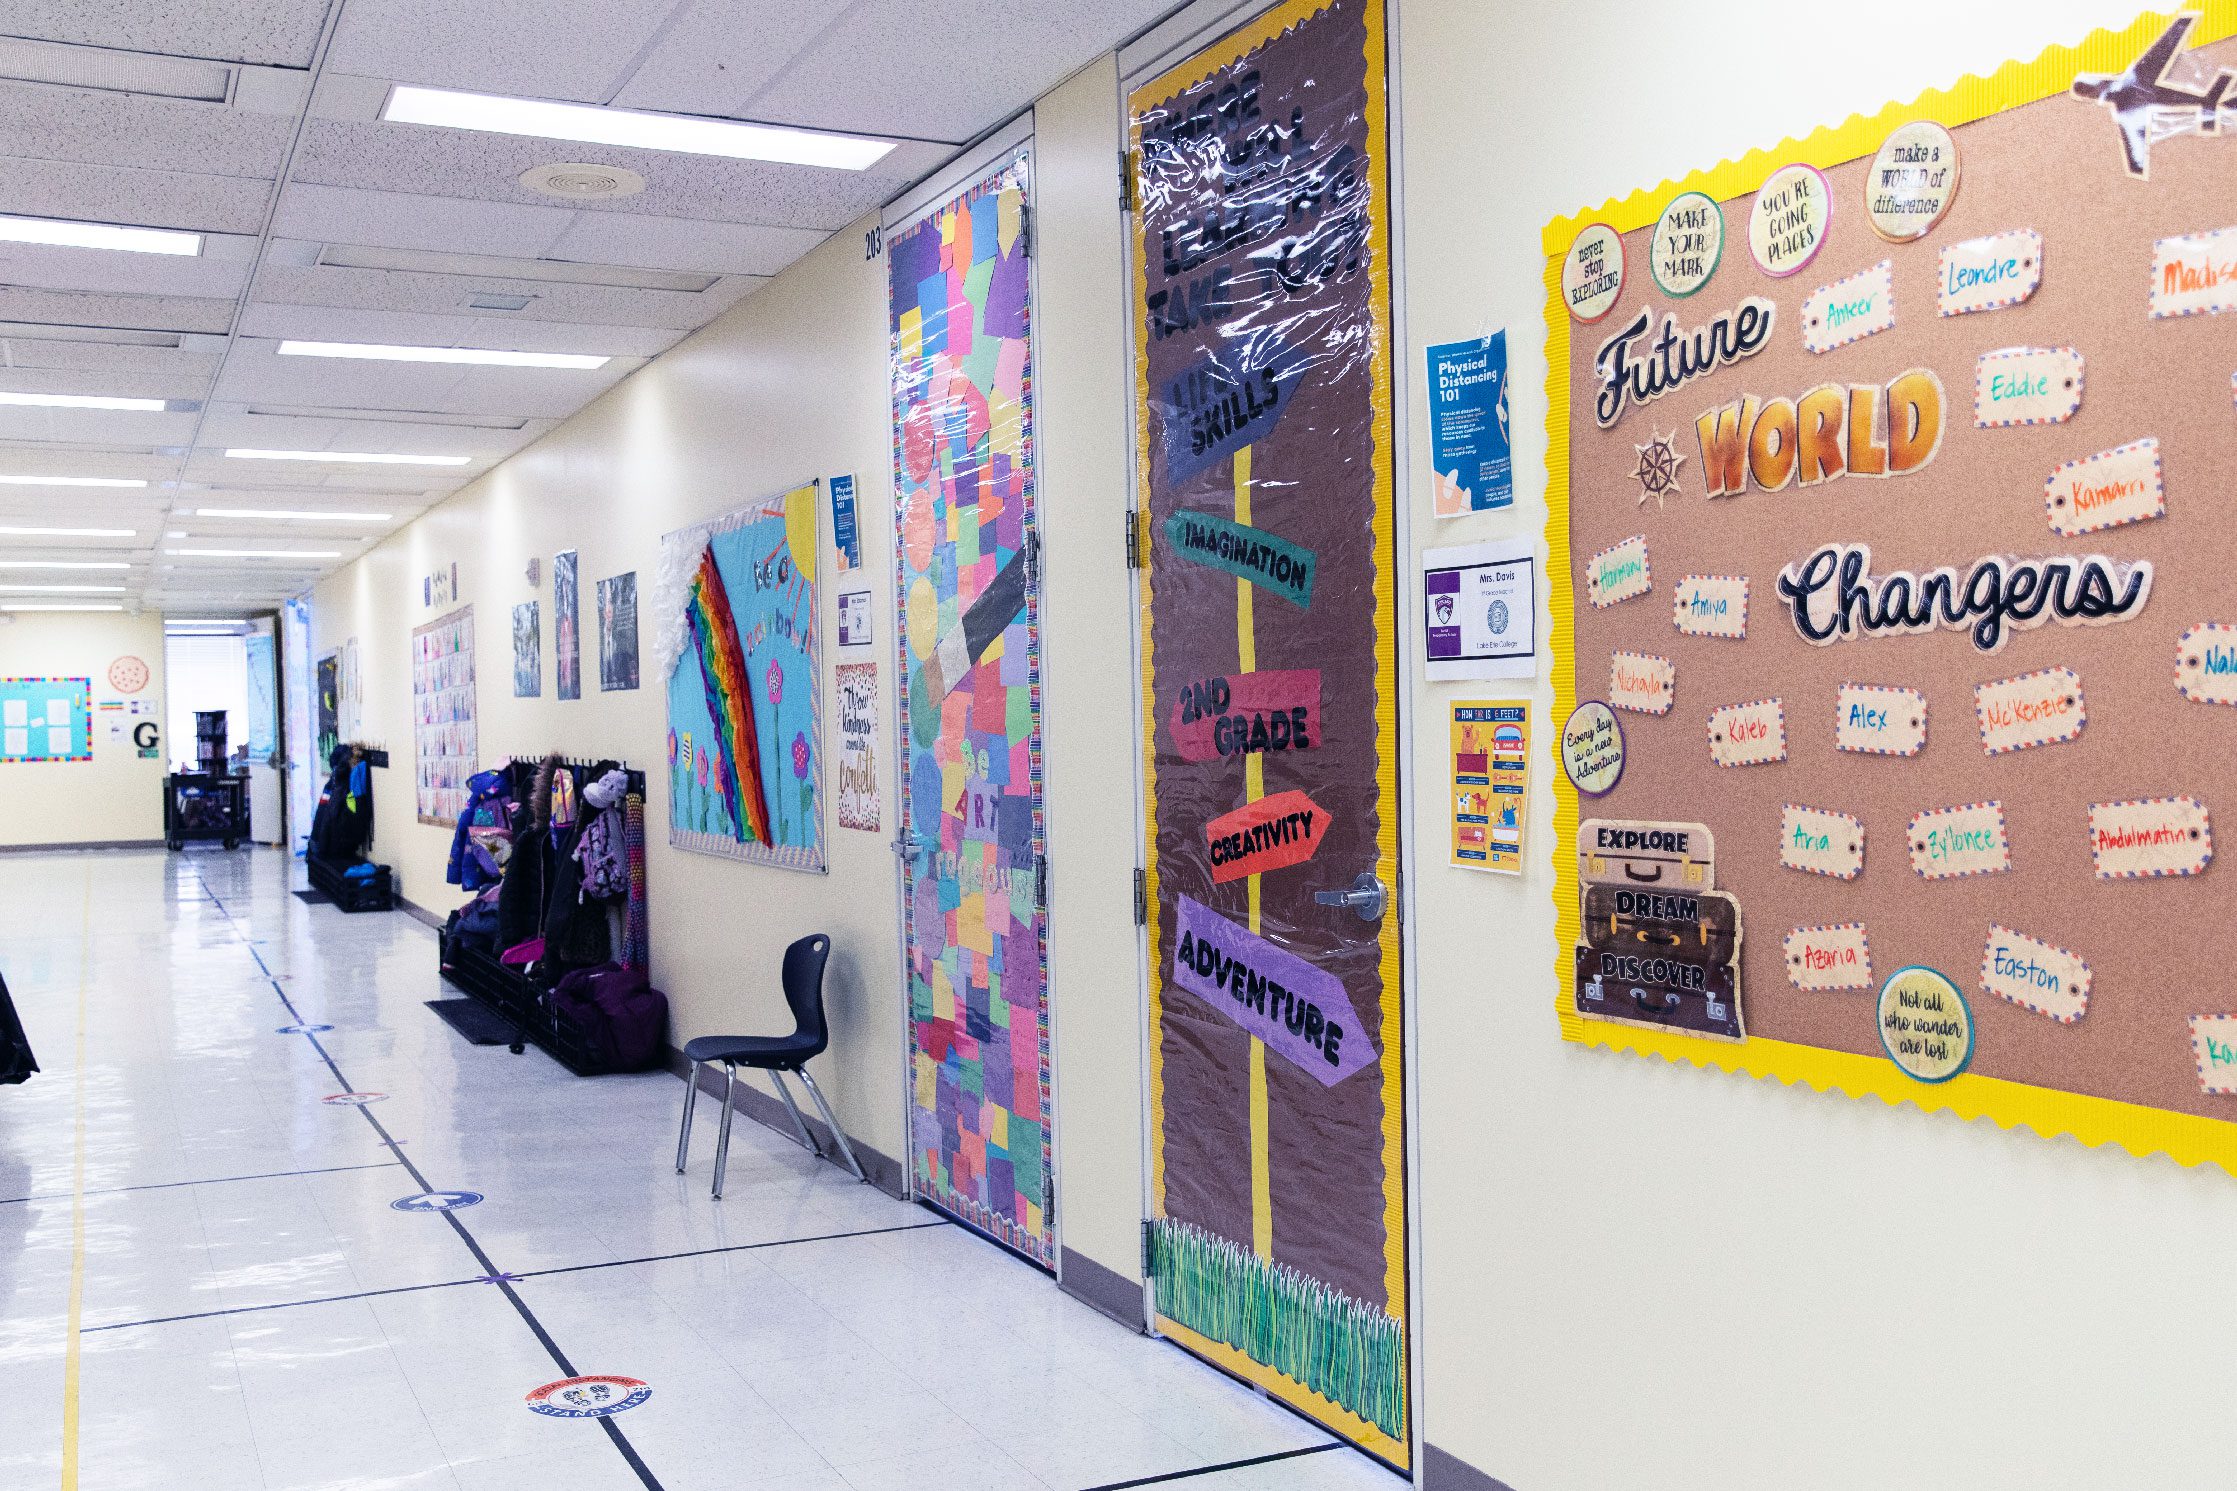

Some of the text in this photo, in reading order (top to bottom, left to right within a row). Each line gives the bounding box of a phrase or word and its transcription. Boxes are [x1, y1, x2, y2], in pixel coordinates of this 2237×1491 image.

[1894, 144, 1940, 164] make a
[1880, 167, 1948, 190] WORLD of
[1763, 177, 1811, 217] YOU'RE
[1873, 193, 1940, 216] difference
[1668, 208, 1708, 232] MAKE
[1769, 207, 1809, 239] GOING
[865, 225, 883, 261] 203
[1578, 239, 1604, 264] never
[1669, 232, 1706, 254] YOUR
[1768, 229, 1815, 264] PLACES
[1584, 258, 1604, 281] stop
[1663, 257, 1706, 279] MARK
[1948, 258, 2020, 296] Leondre
[1571, 269, 1619, 306] EXPLORING
[1438, 354, 1487, 376] Physical
[1439, 368, 1497, 389] Distancing
[1597, 305, 1771, 424] Future
[1439, 389, 1460, 402] 101
[1991, 373, 2049, 402] Eddie
[1191, 366, 1279, 457] SKILLS
[1694, 371, 1942, 496] WORLD
[2071, 478, 2146, 516] Kamarri
[1184, 521, 1307, 591] IMAGINATION
[1479, 570, 1515, 584] Mrs. Davis
[1690, 590, 1728, 617] Amiya
[1778, 548, 2145, 651] Changers
[2204, 644, 2237, 675] Nal
[1179, 676, 1231, 725] 2ND
[1485, 709, 1491, 720] IS
[1500, 709, 1519, 719] FEET?
[1213, 706, 1311, 757] GRADE
[1566, 717, 1613, 748] Every day
[1728, 717, 1768, 744] Kaleb
[1849, 703, 1888, 733] Alex
[133, 722, 160, 748] G
[1573, 736, 1613, 763] is a new
[839, 744, 878, 814] confetti
[1575, 752, 1621, 782] Adventure
[954, 788, 1000, 832] ART
[1210, 810, 1313, 867] CREATIVITY
[1597, 828, 1689, 854] EXPLORE
[1793, 823, 1830, 851] Aria
[2098, 823, 2186, 851] Abdulmatin
[1615, 891, 1699, 923] DREAM
[1804, 945, 1857, 970] Azaria
[1994, 947, 2060, 994] Easton
[1600, 953, 1707, 992] DISCOVER
[1177, 930, 1344, 1067] ADVENTURE
[1899, 989, 1945, 1013] Not all
[1884, 1014, 1963, 1039] who wander
[1899, 1038, 1949, 1061] are lost
[2206, 1036, 2237, 1069] Ka
[540, 1393, 645, 1417] STAND HERE
